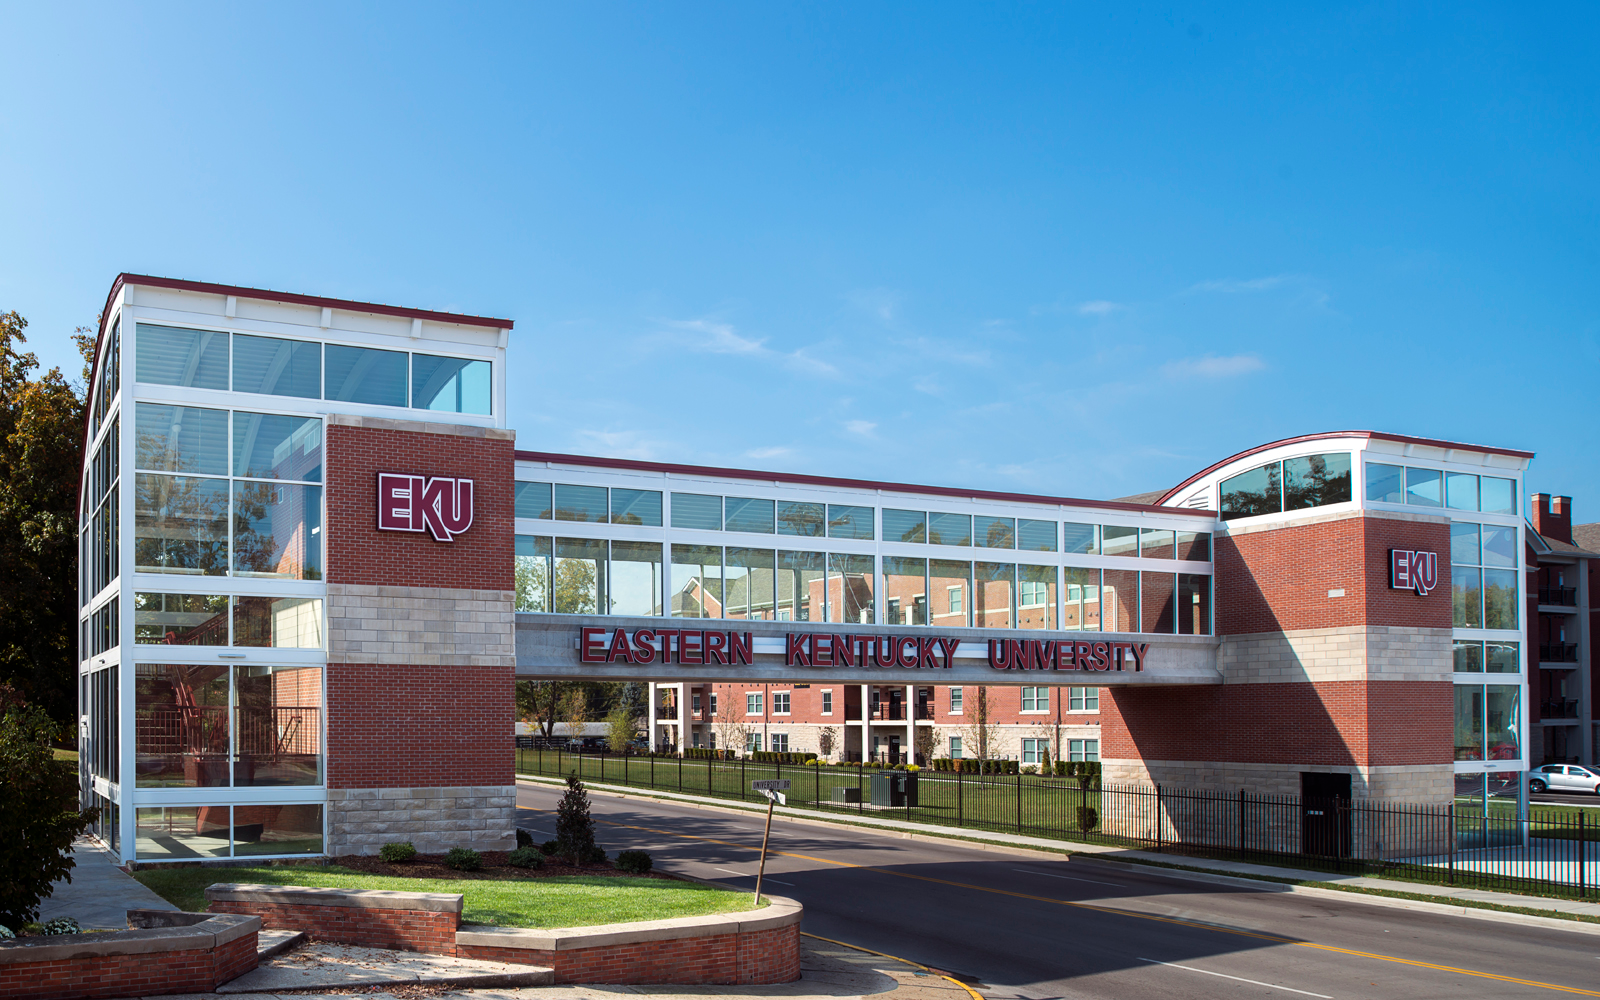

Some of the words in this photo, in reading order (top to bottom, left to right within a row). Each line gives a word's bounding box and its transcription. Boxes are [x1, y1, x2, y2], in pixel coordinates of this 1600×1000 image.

[377, 471, 475, 542] EKU
[1390, 548, 1438, 596] EKU
[580, 626, 753, 665] EASTERN
[786, 633, 961, 669] KENTUCKY
[989, 639, 1151, 672] UNIVERSITY
[753, 780, 780, 789] UNIVERSITY
[783, 780, 790, 788] DR
